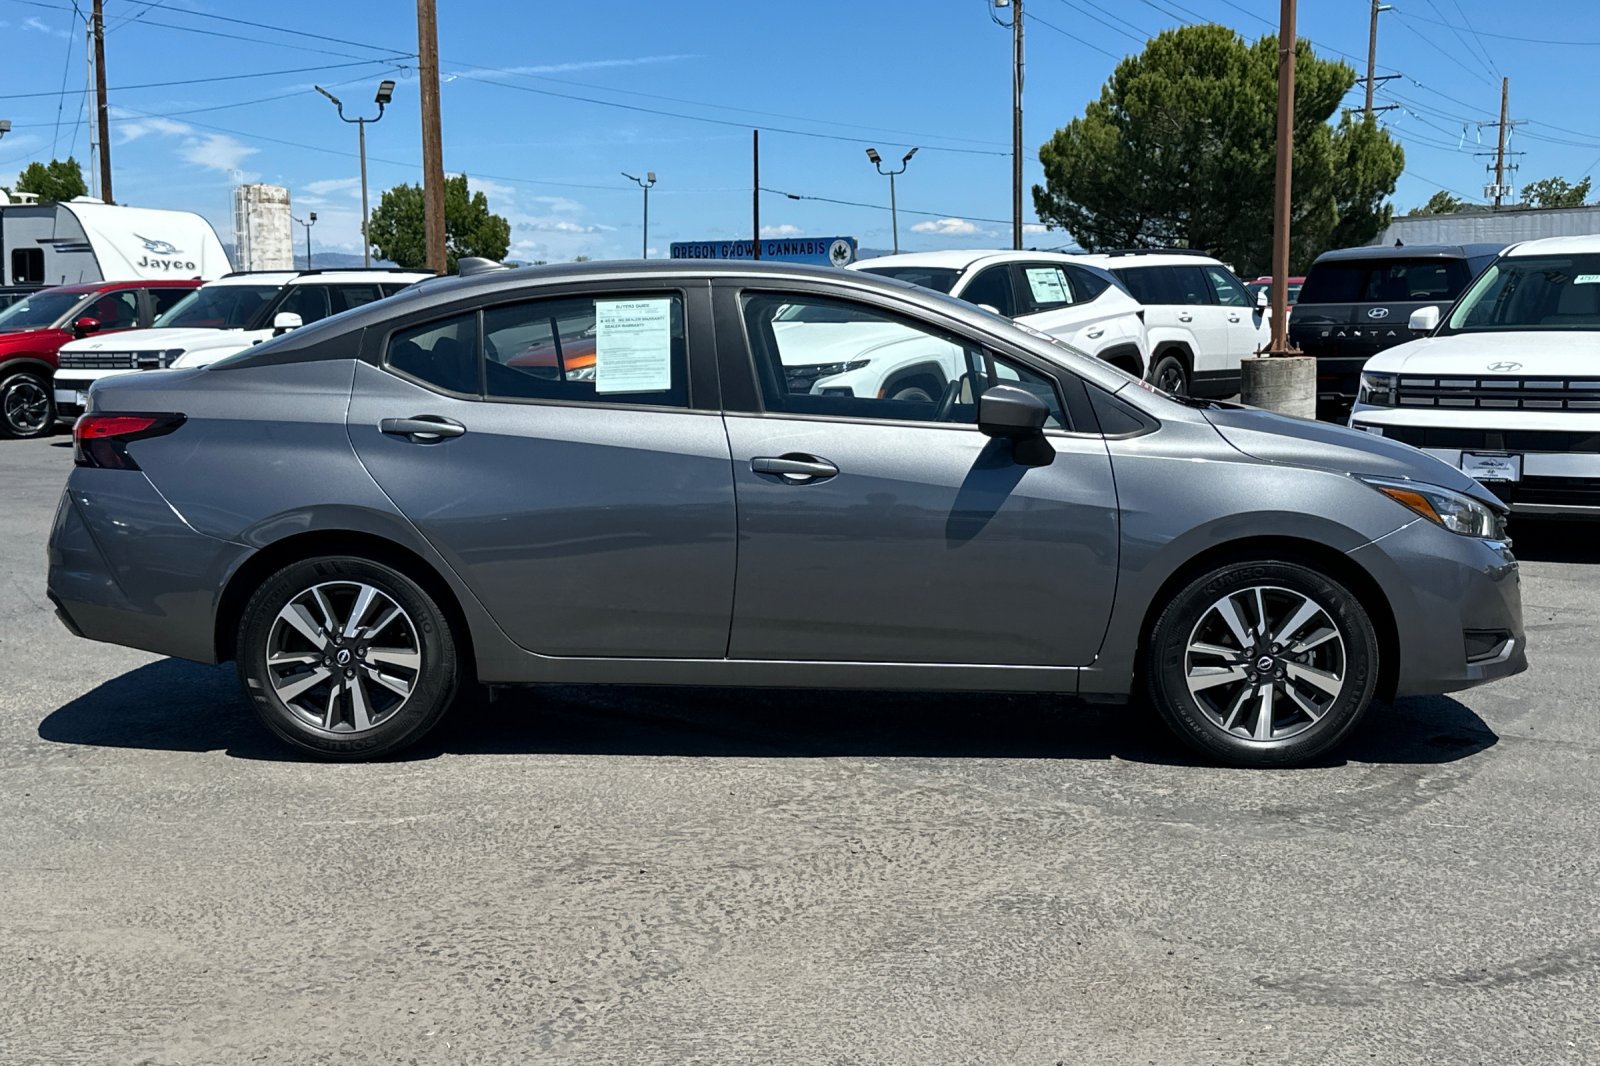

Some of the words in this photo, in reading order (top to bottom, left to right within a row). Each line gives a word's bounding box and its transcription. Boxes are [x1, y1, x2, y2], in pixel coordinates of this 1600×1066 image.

[673, 244, 716, 259] OREGON
[767, 242, 825, 256] CANNABIS
[136, 255, 197, 272] Jayco
